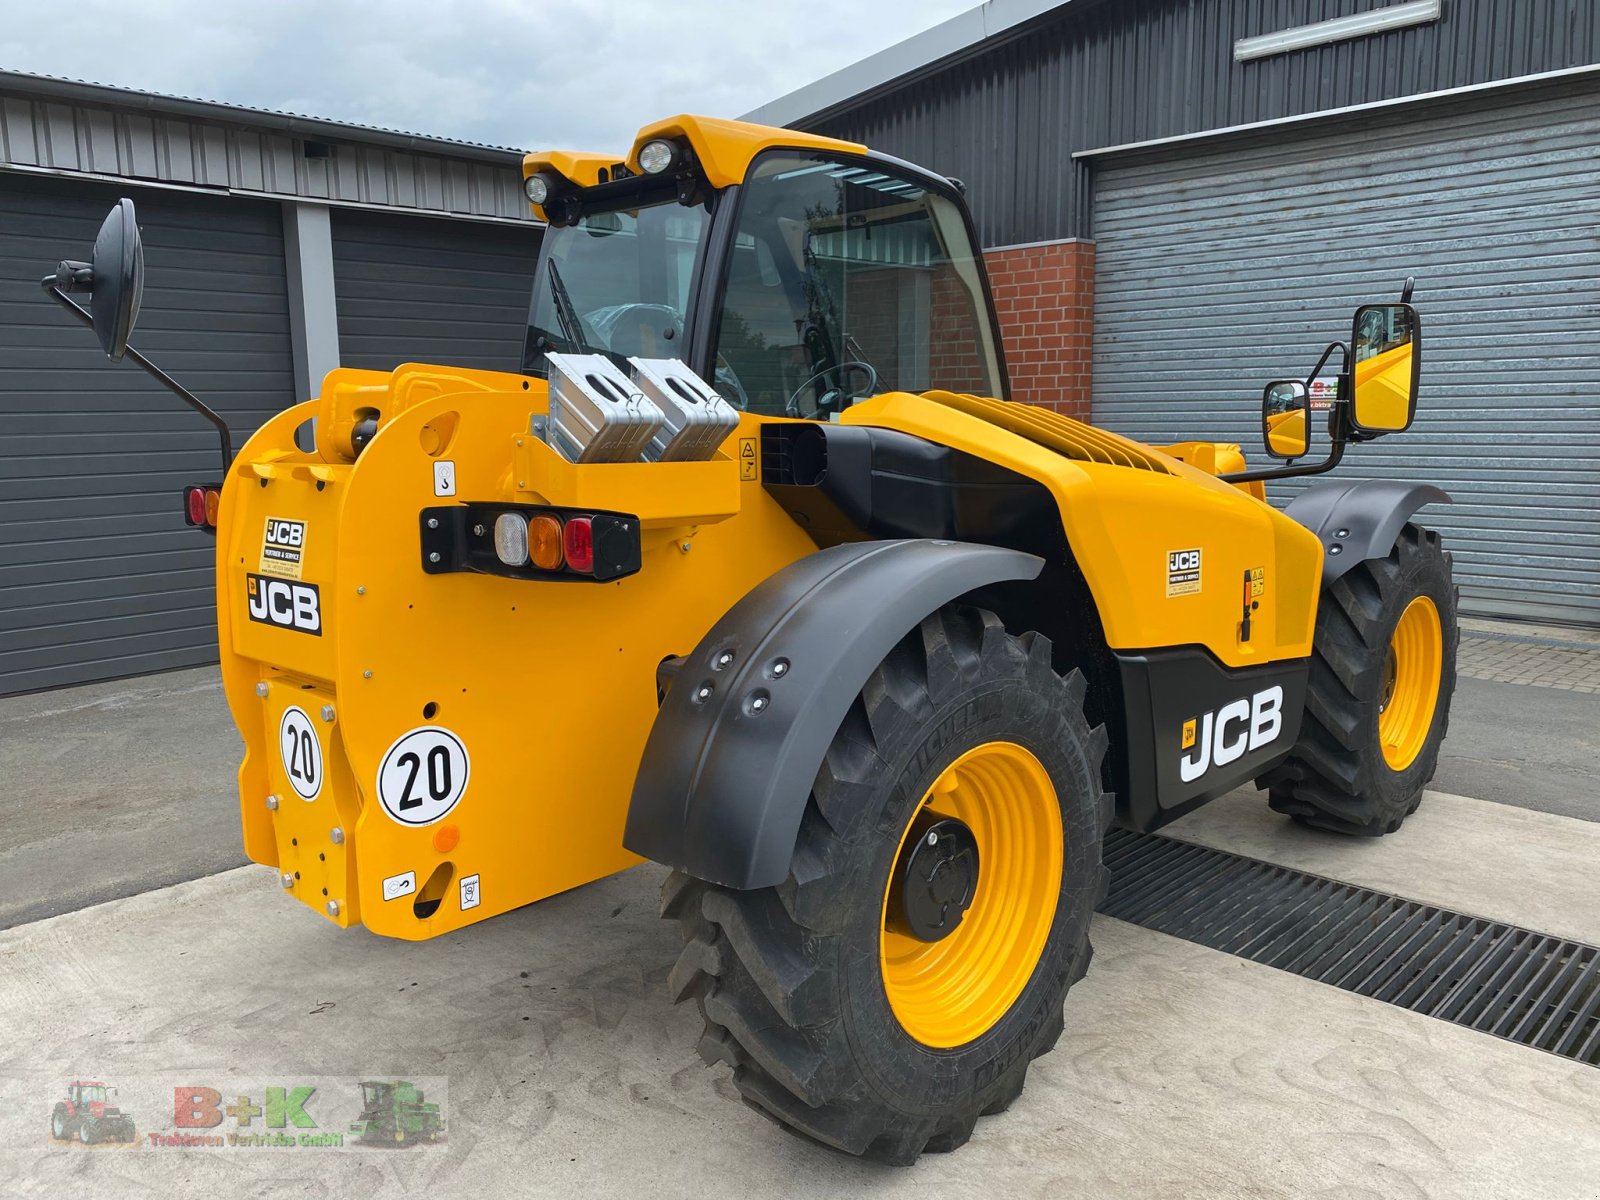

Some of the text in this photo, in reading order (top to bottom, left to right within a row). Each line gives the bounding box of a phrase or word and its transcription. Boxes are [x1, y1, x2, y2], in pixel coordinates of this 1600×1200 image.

[268, 522, 302, 546] JCB
[1170, 551, 1199, 570] JCB
[249, 579, 320, 631] JCB
[287, 723, 315, 784] 20
[1180, 685, 1284, 783] JCB
[396, 744, 452, 812] 20
